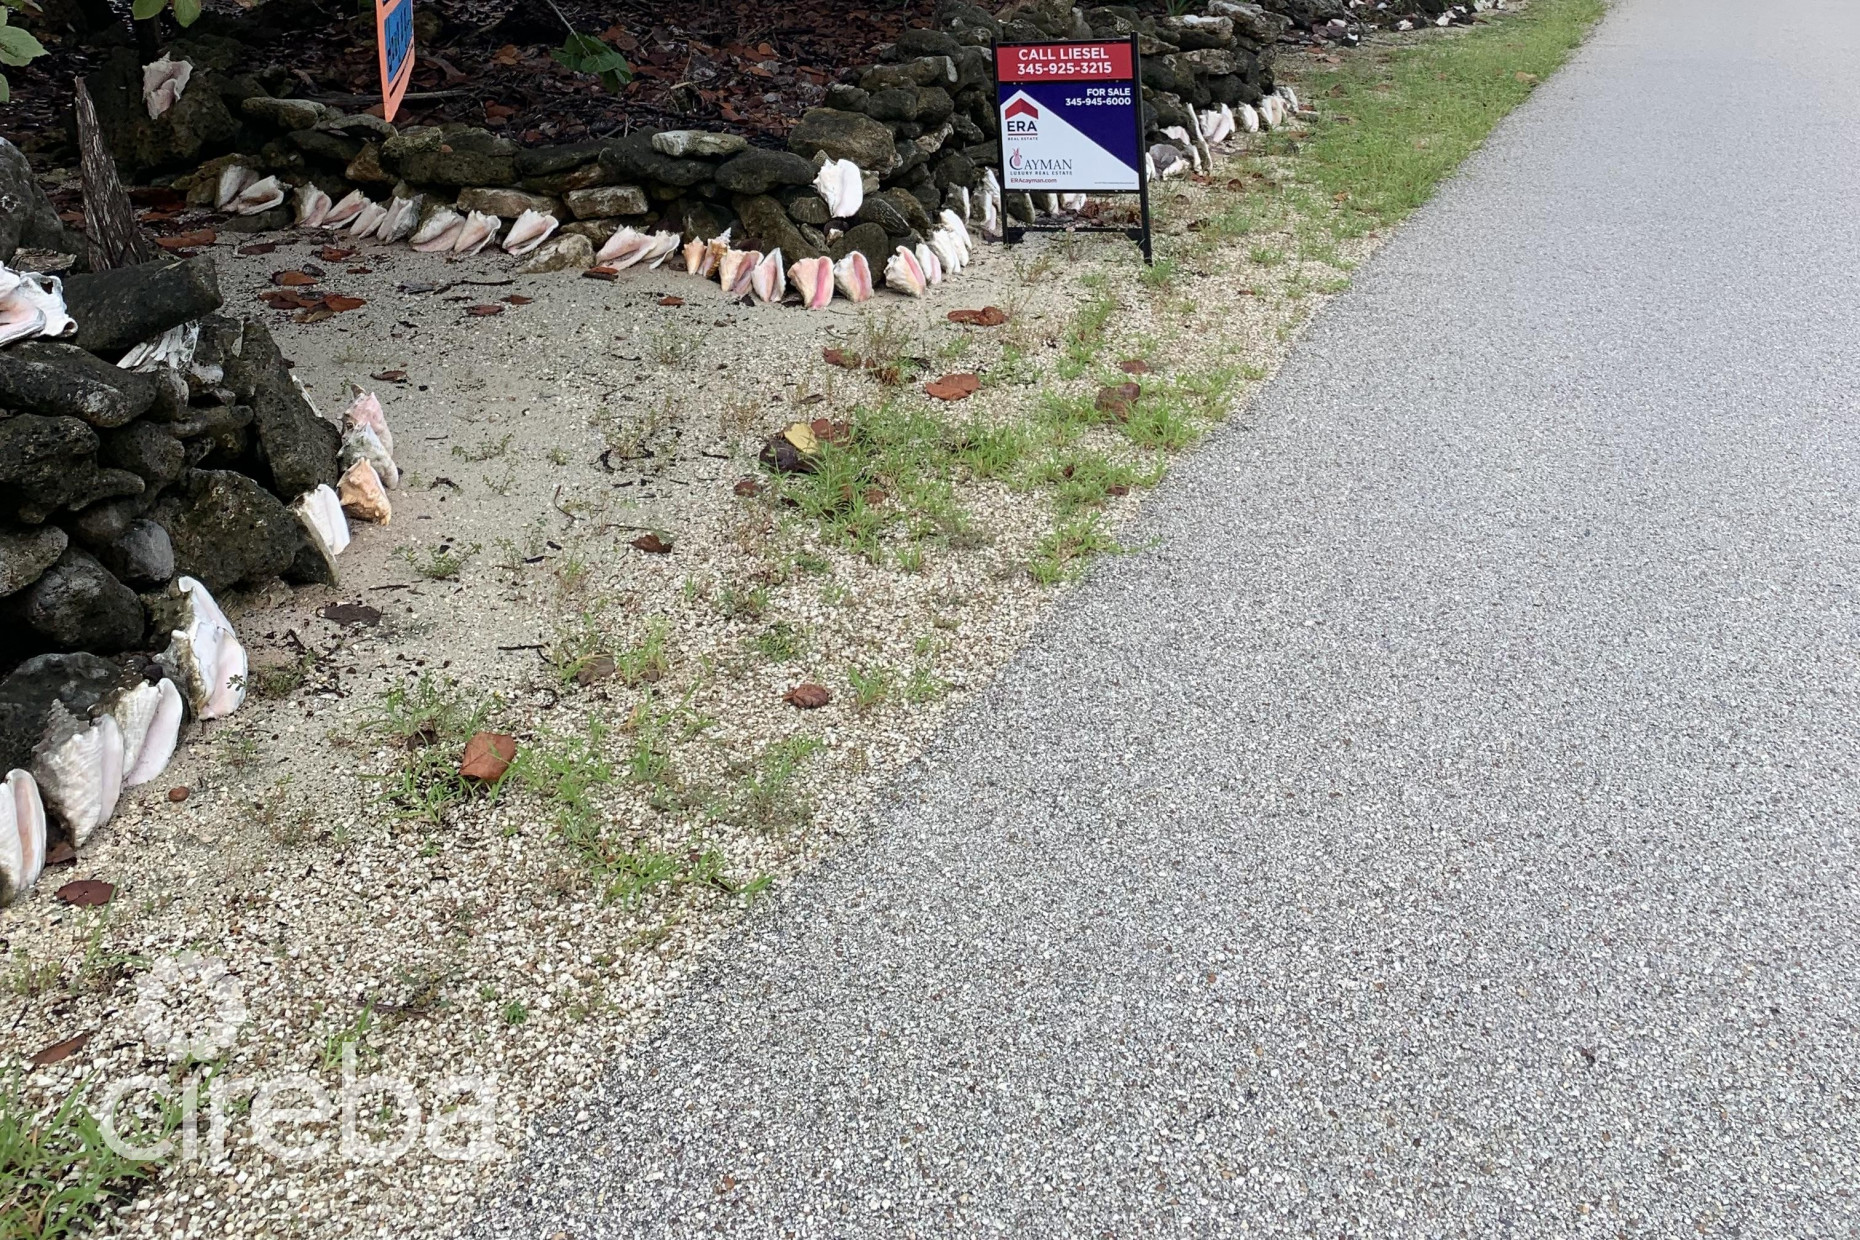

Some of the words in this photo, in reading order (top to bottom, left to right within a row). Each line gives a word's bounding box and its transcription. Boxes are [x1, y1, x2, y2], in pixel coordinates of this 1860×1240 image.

[1018, 48, 1056, 61] CALL
[1059, 47, 1109, 60] LIESEL
[1017, 62, 1112, 75] 345-925-3215
[1086, 88, 1106, 97] FOR
[1108, 87, 1131, 96] SALE
[1065, 97, 1132, 106] 345-945-6000
[1007, 120, 1038, 132] ERA
[1009, 154, 1073, 171] CAYMAN
